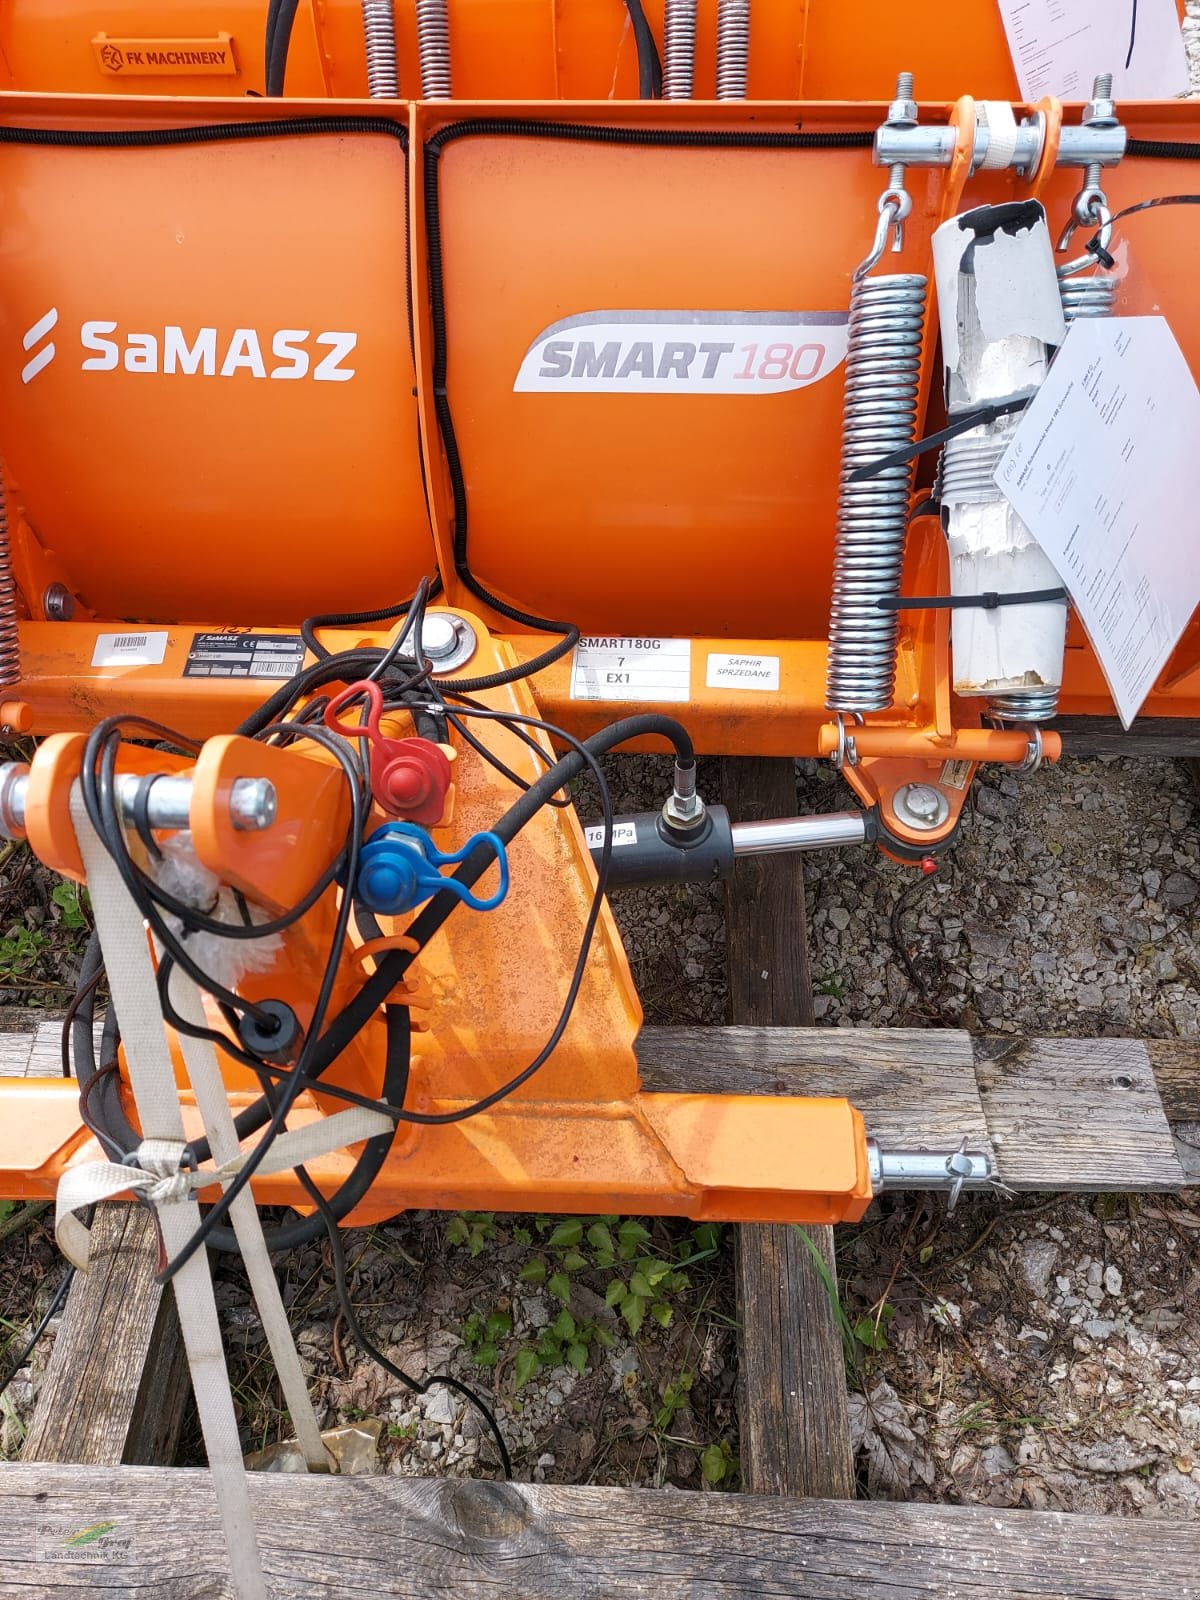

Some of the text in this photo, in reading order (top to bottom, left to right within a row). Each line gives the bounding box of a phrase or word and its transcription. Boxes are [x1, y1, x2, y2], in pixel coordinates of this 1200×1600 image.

[126, 52, 226, 64] FK MACHINERY
[80, 320, 358, 382] SaMASZ
[538, 341, 826, 381] SMART 180
[578, 638, 661, 650] SMART180G
[617, 657, 626, 667] 7
[727, 658, 763, 668] SAPHIR
[606, 673, 630, 683] EX1
[716, 668, 772, 679] SPRZEDANE
[588, 831, 603, 842] 16
